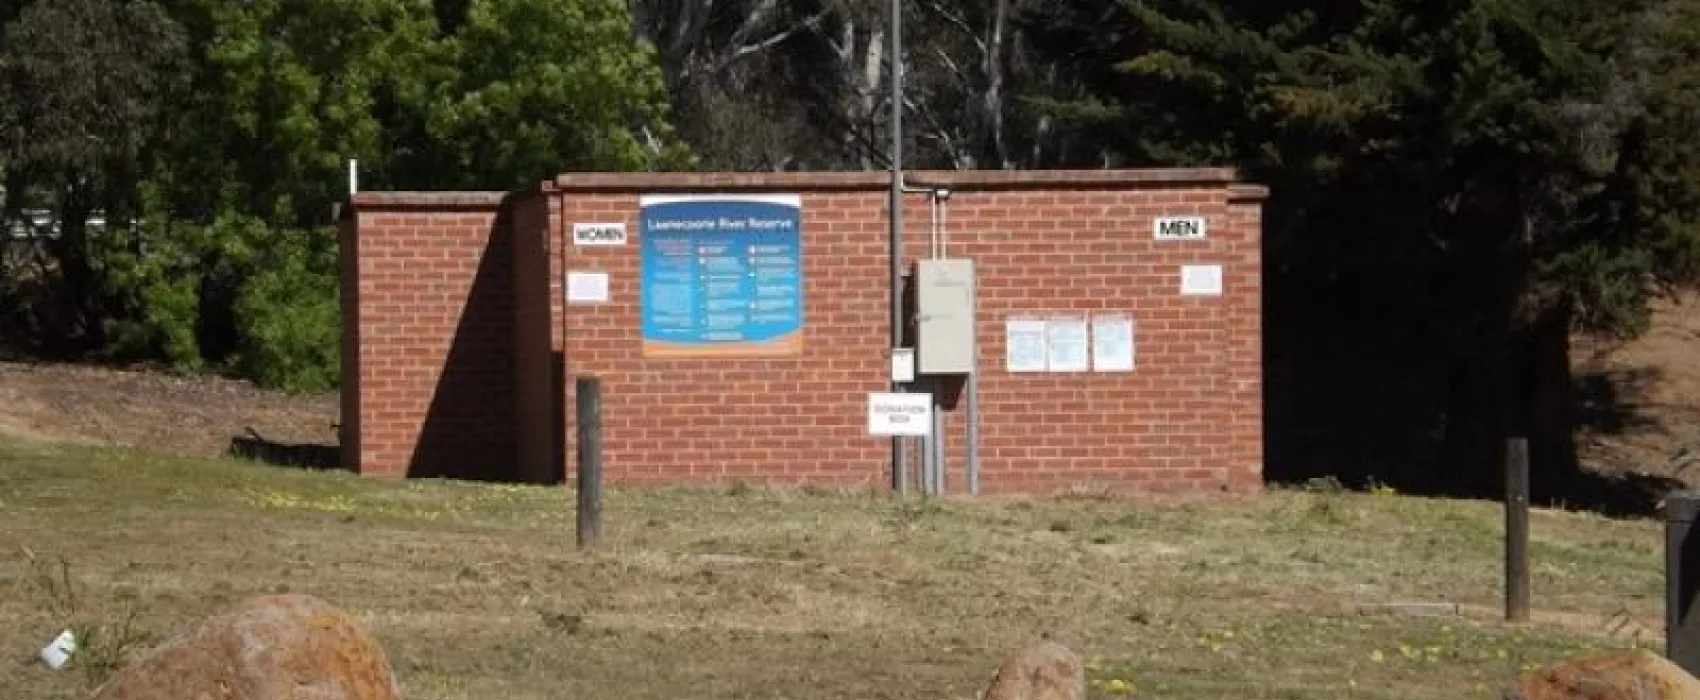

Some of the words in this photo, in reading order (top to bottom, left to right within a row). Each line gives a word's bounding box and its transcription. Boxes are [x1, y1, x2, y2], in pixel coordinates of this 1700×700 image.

[719, 217, 746, 229] River
[748, 217, 793, 229] Reserve
[1159, 220, 1199, 236] MEN
[576, 226, 625, 241] WOMEN
[874, 404, 927, 414] DONATION
[889, 414, 911, 423] BOX
